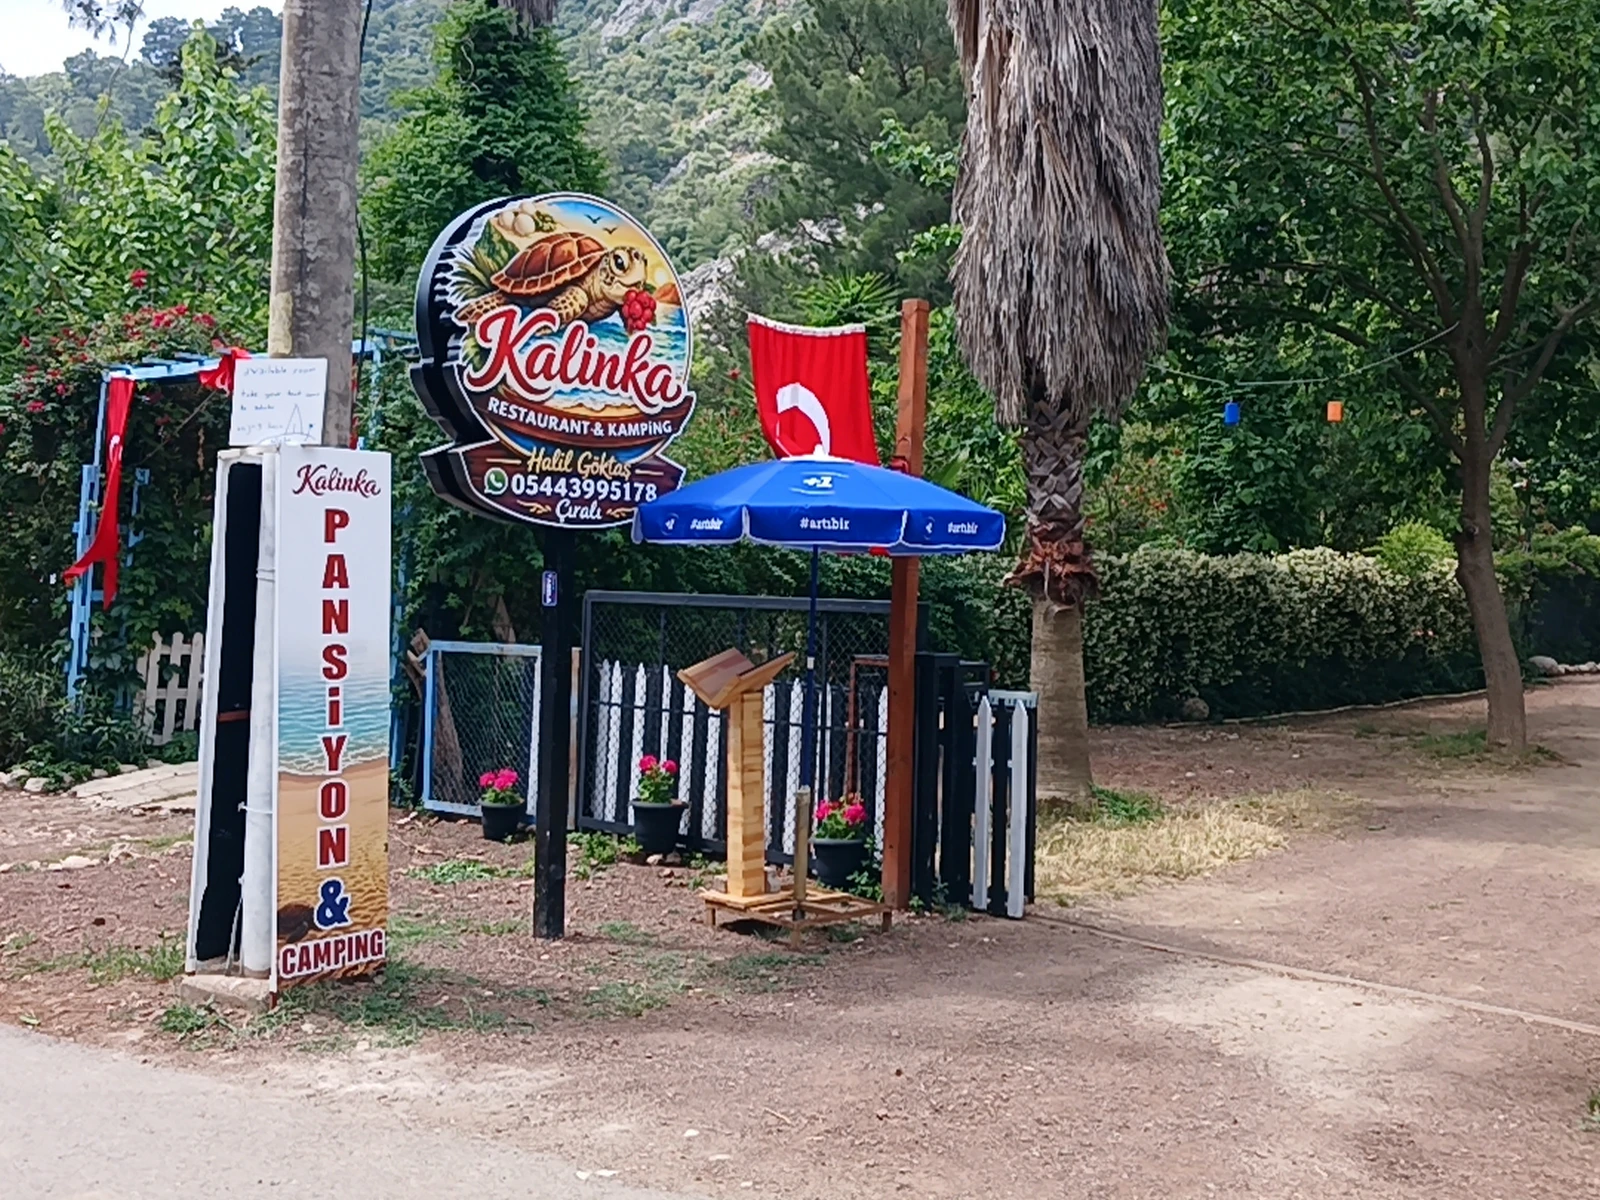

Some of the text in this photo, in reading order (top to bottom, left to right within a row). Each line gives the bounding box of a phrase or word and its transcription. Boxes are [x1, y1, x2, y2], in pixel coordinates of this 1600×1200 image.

[466, 307, 682, 408] Kalinka
[487, 396, 591, 435] RESTAURANT
[593, 421, 605, 437] &
[292, 464, 381, 499] Kalinka
[526, 446, 632, 481] Halil Göktaş
[511, 473, 658, 502] 05443995178
[555, 499, 603, 524] Çıralı
[316, 879, 350, 928] &
[281, 930, 384, 976] CAMPING
